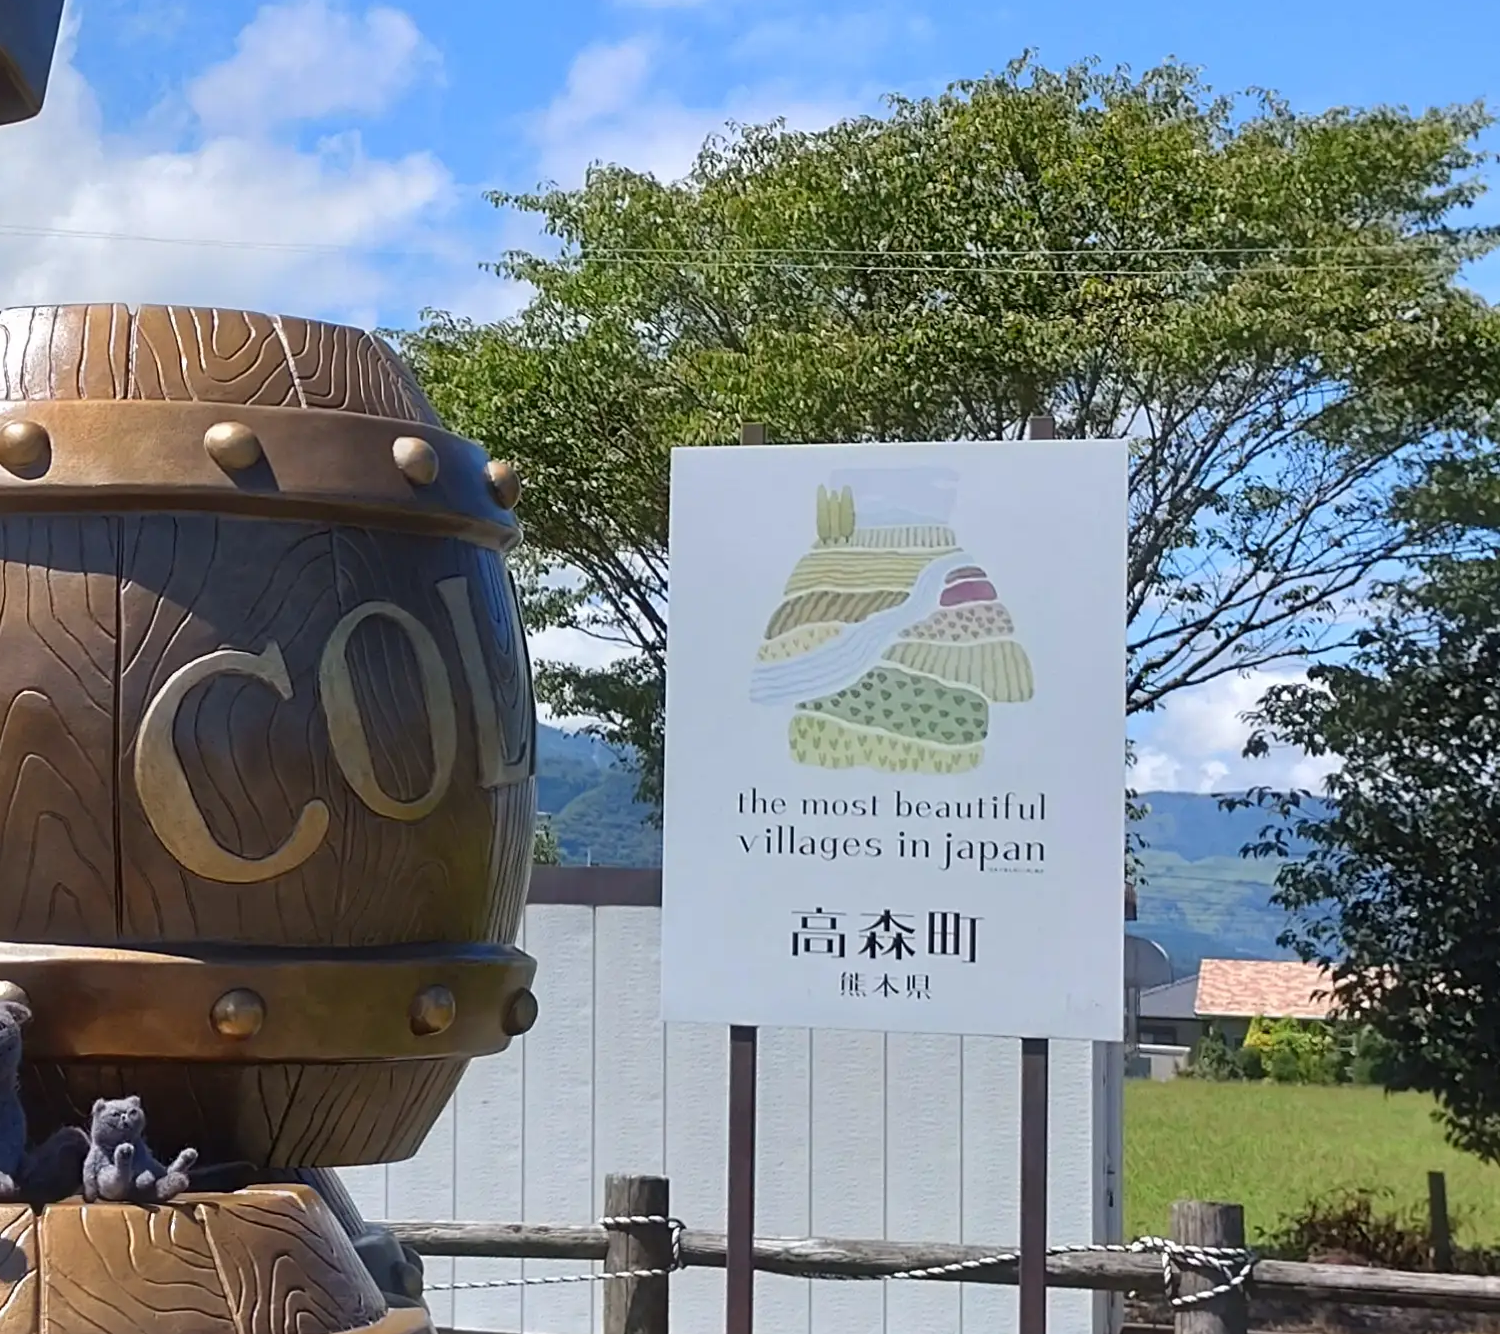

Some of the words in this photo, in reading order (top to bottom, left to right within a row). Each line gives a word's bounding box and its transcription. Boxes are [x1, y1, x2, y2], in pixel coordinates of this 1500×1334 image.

[736, 788, 787, 815] the
[800, 794, 880, 817] most
[894, 790, 1045, 820] beautiful
[736, 825, 882, 861] villages
[898, 831, 930, 858] in
[938, 832, 1045, 872] japan
[791, 906, 985, 963] 高森町
[840, 971, 931, 999] 熊本県
